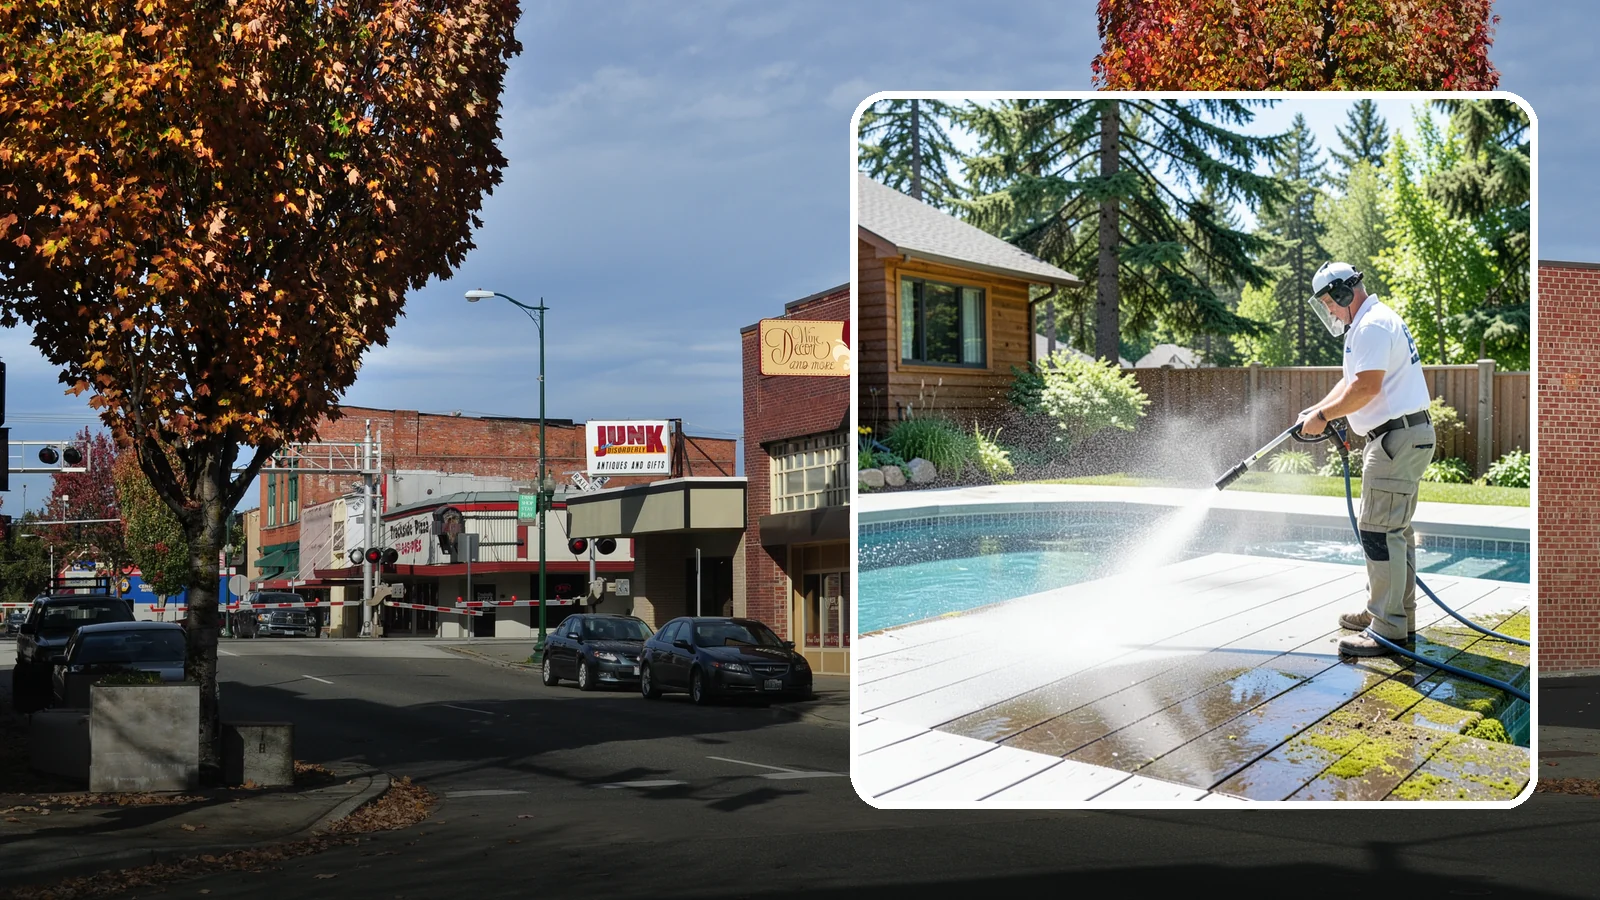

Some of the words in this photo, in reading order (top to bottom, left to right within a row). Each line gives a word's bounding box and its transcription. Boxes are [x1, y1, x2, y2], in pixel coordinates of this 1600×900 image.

[765, 328, 831, 366] Decor
[595, 425, 665, 457] JUNK
[607, 446, 646, 454] DISORDERLY
[597, 461, 628, 470] ANTIQUES
[631, 461, 644, 470] AND
[647, 460, 665, 470] GIFTS
[352, 498, 365, 511] CRO
[414, 519, 429, 535] Pizza
